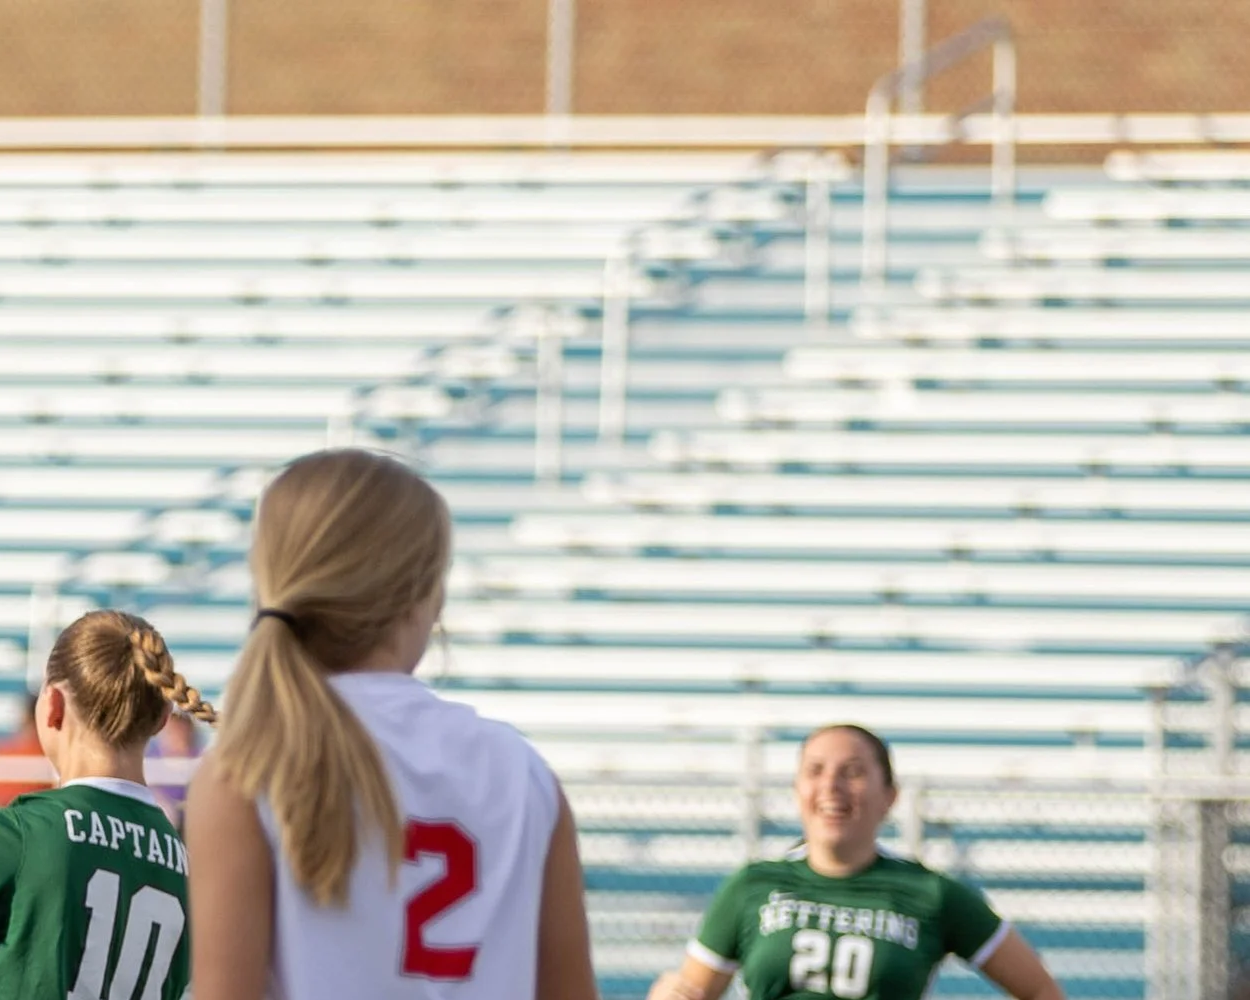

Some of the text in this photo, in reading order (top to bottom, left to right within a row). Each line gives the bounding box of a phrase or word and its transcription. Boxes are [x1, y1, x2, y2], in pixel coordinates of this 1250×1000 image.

[64, 808, 190, 877] CAPTAIN
[400, 815, 491, 983] 2
[789, 928, 875, 1000] 20
